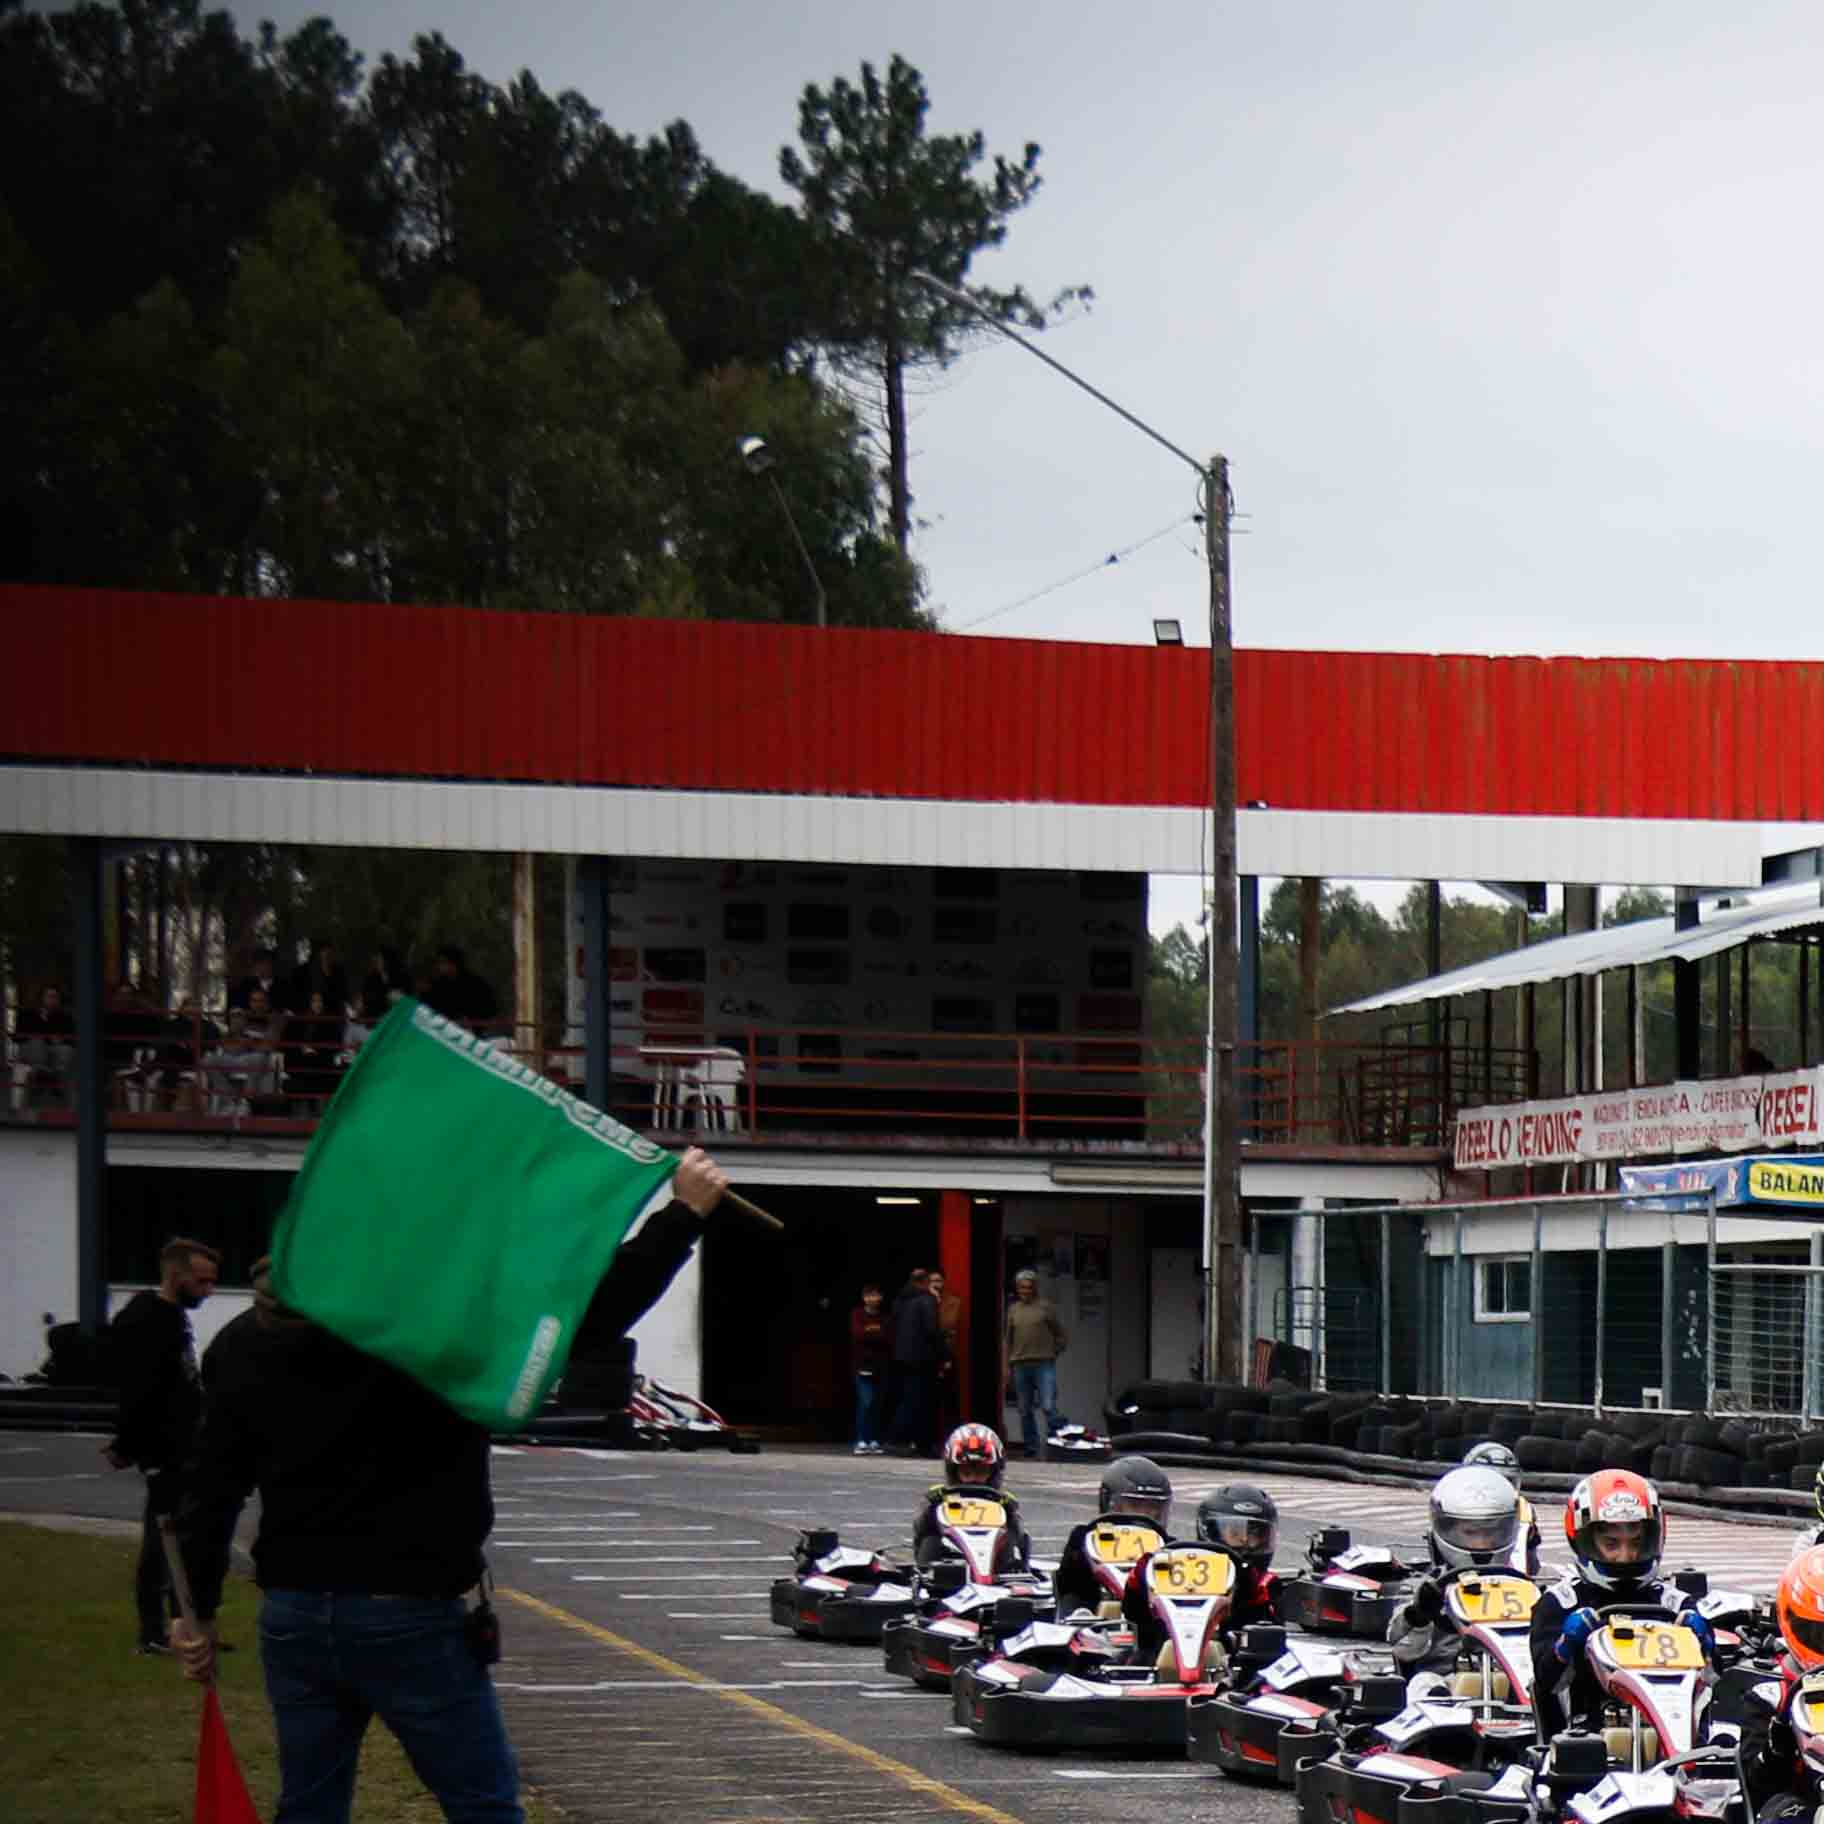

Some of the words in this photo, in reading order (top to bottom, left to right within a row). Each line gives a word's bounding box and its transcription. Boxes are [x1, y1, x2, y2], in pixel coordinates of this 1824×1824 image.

[1168, 1559, 1211, 1588] 63
[1480, 1590, 1524, 1616] 75
[1632, 1632, 1680, 1660] 78
